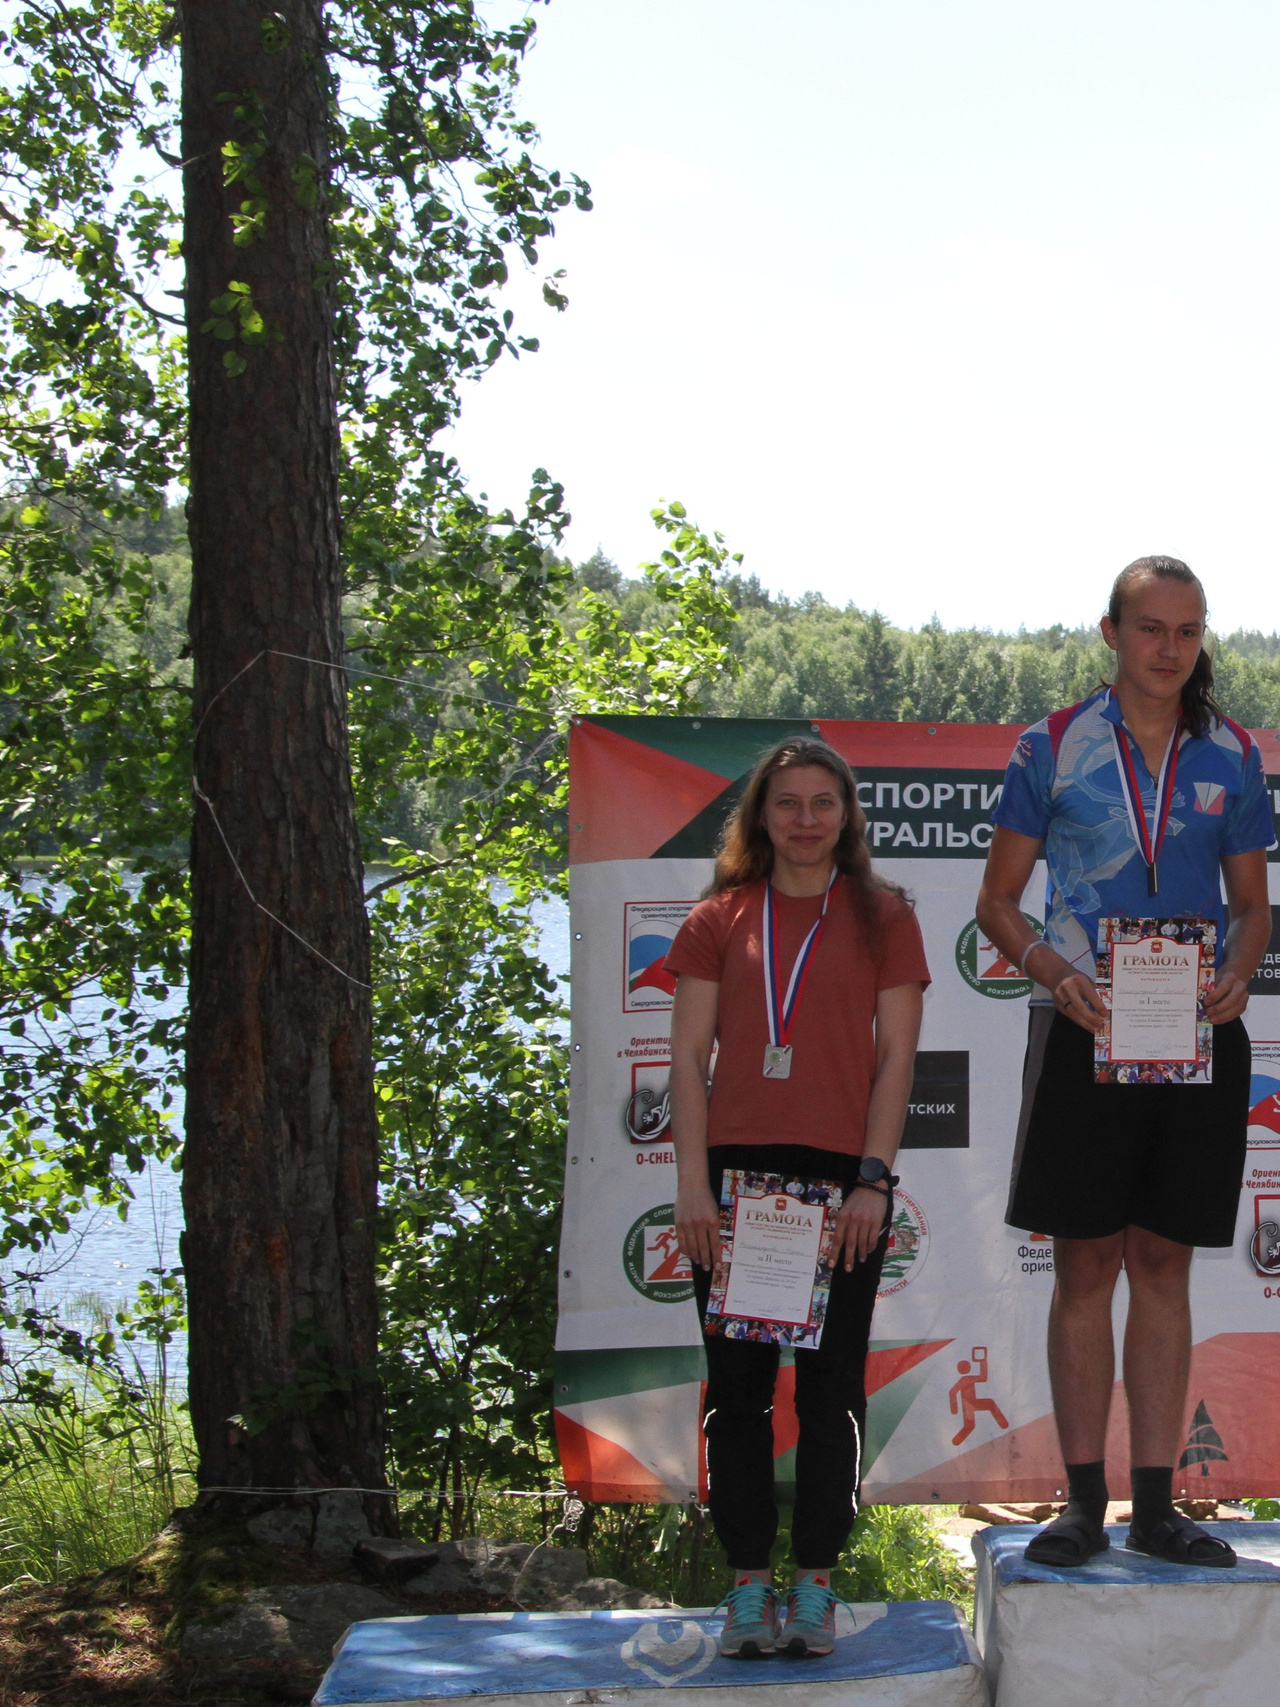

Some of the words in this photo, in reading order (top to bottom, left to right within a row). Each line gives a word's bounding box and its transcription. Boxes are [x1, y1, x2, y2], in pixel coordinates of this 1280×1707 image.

[866, 821, 994, 848] РАЛЬС
[1123, 955, 1189, 966] ГРАМОТА
[908, 1104, 956, 1115] ТСКИХ
[745, 1210, 812, 1228] ГРАМОТА
[1017, 1245, 1052, 1260] Феде
[1021, 1262, 1054, 1276] орие
